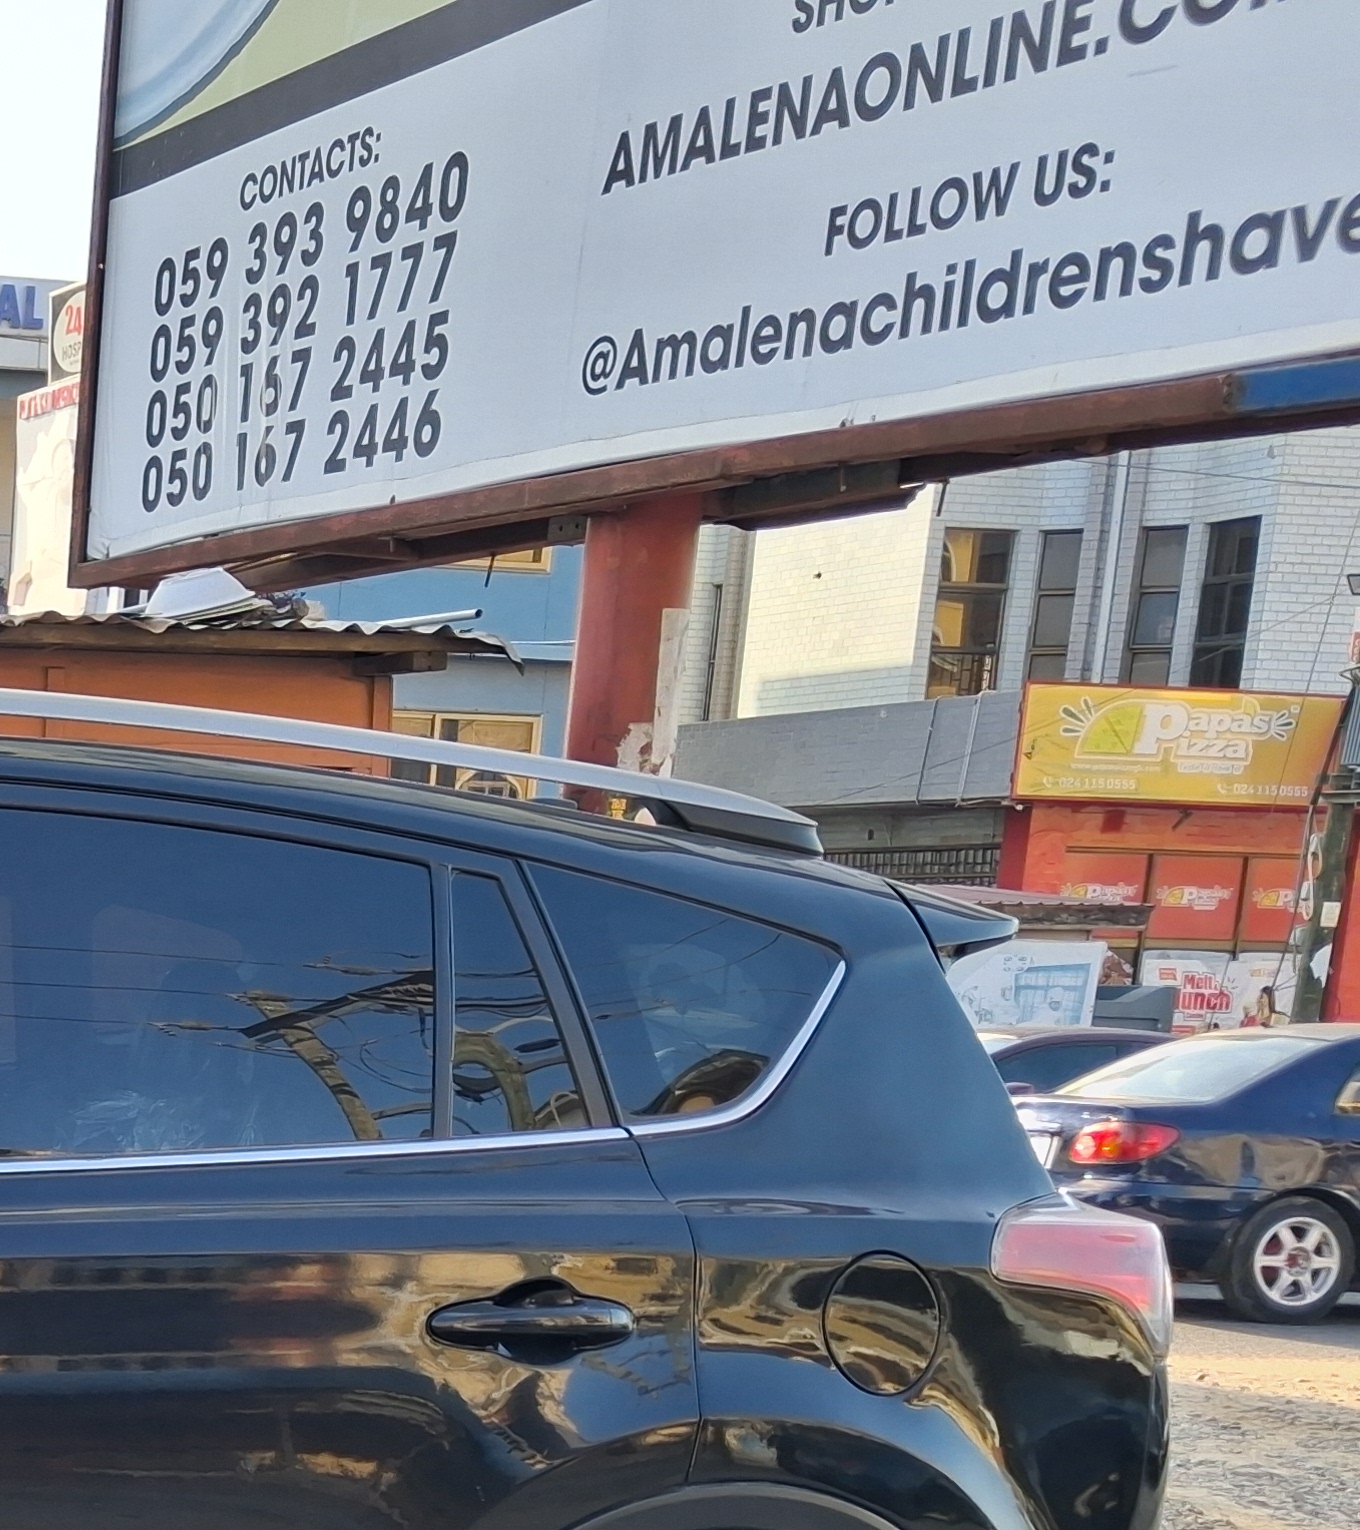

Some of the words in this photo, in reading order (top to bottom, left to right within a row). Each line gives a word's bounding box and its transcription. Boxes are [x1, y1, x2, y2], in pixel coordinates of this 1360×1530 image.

[155, 237, 229, 317] 059
[245, 201, 324, 285] 393
[346, 151, 469, 253] 9840
[240, 126, 382, 211] CONTACTS:
[824, 161, 1020, 257] FOLLOW
[1033, 142, 1116, 207] US:
[149, 306, 224, 383] 059
[240, 274, 319, 355] 392
[345, 230, 458, 326] 1777
[146, 374, 218, 448] 050
[240, 346, 312, 423] 167
[330, 309, 450, 402] 2445
[142, 441, 213, 512] 050
[236, 418, 306, 491] 167
[323, 388, 442, 475] 2446
